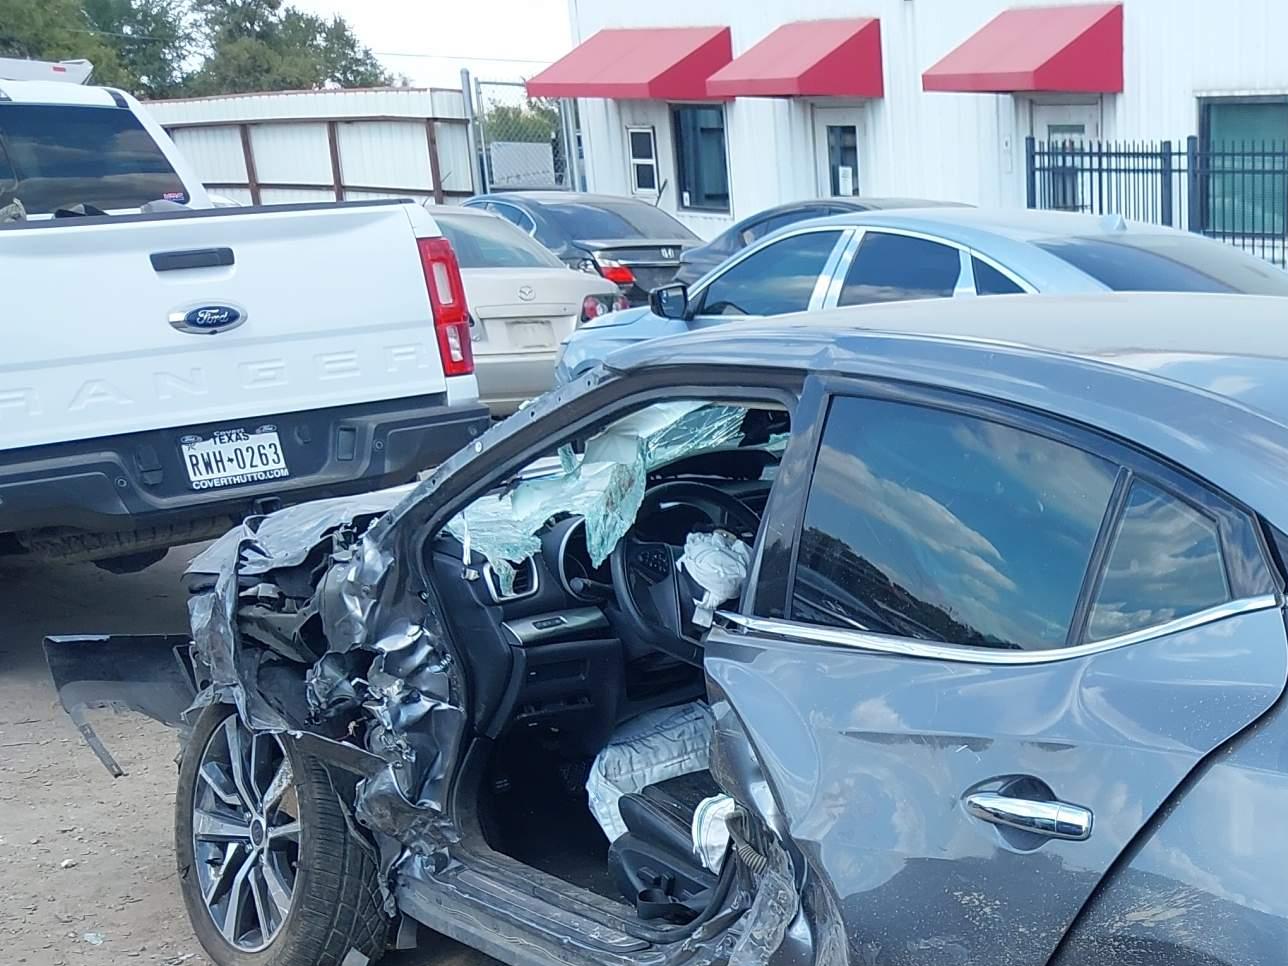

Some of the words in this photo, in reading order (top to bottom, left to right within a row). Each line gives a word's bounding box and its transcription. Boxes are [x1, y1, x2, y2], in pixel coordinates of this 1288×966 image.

[196, 308, 229, 325] Ford
[211, 431, 250, 445] TEXAS
[192, 468, 289, 490] COVERTHUTTO.COM
